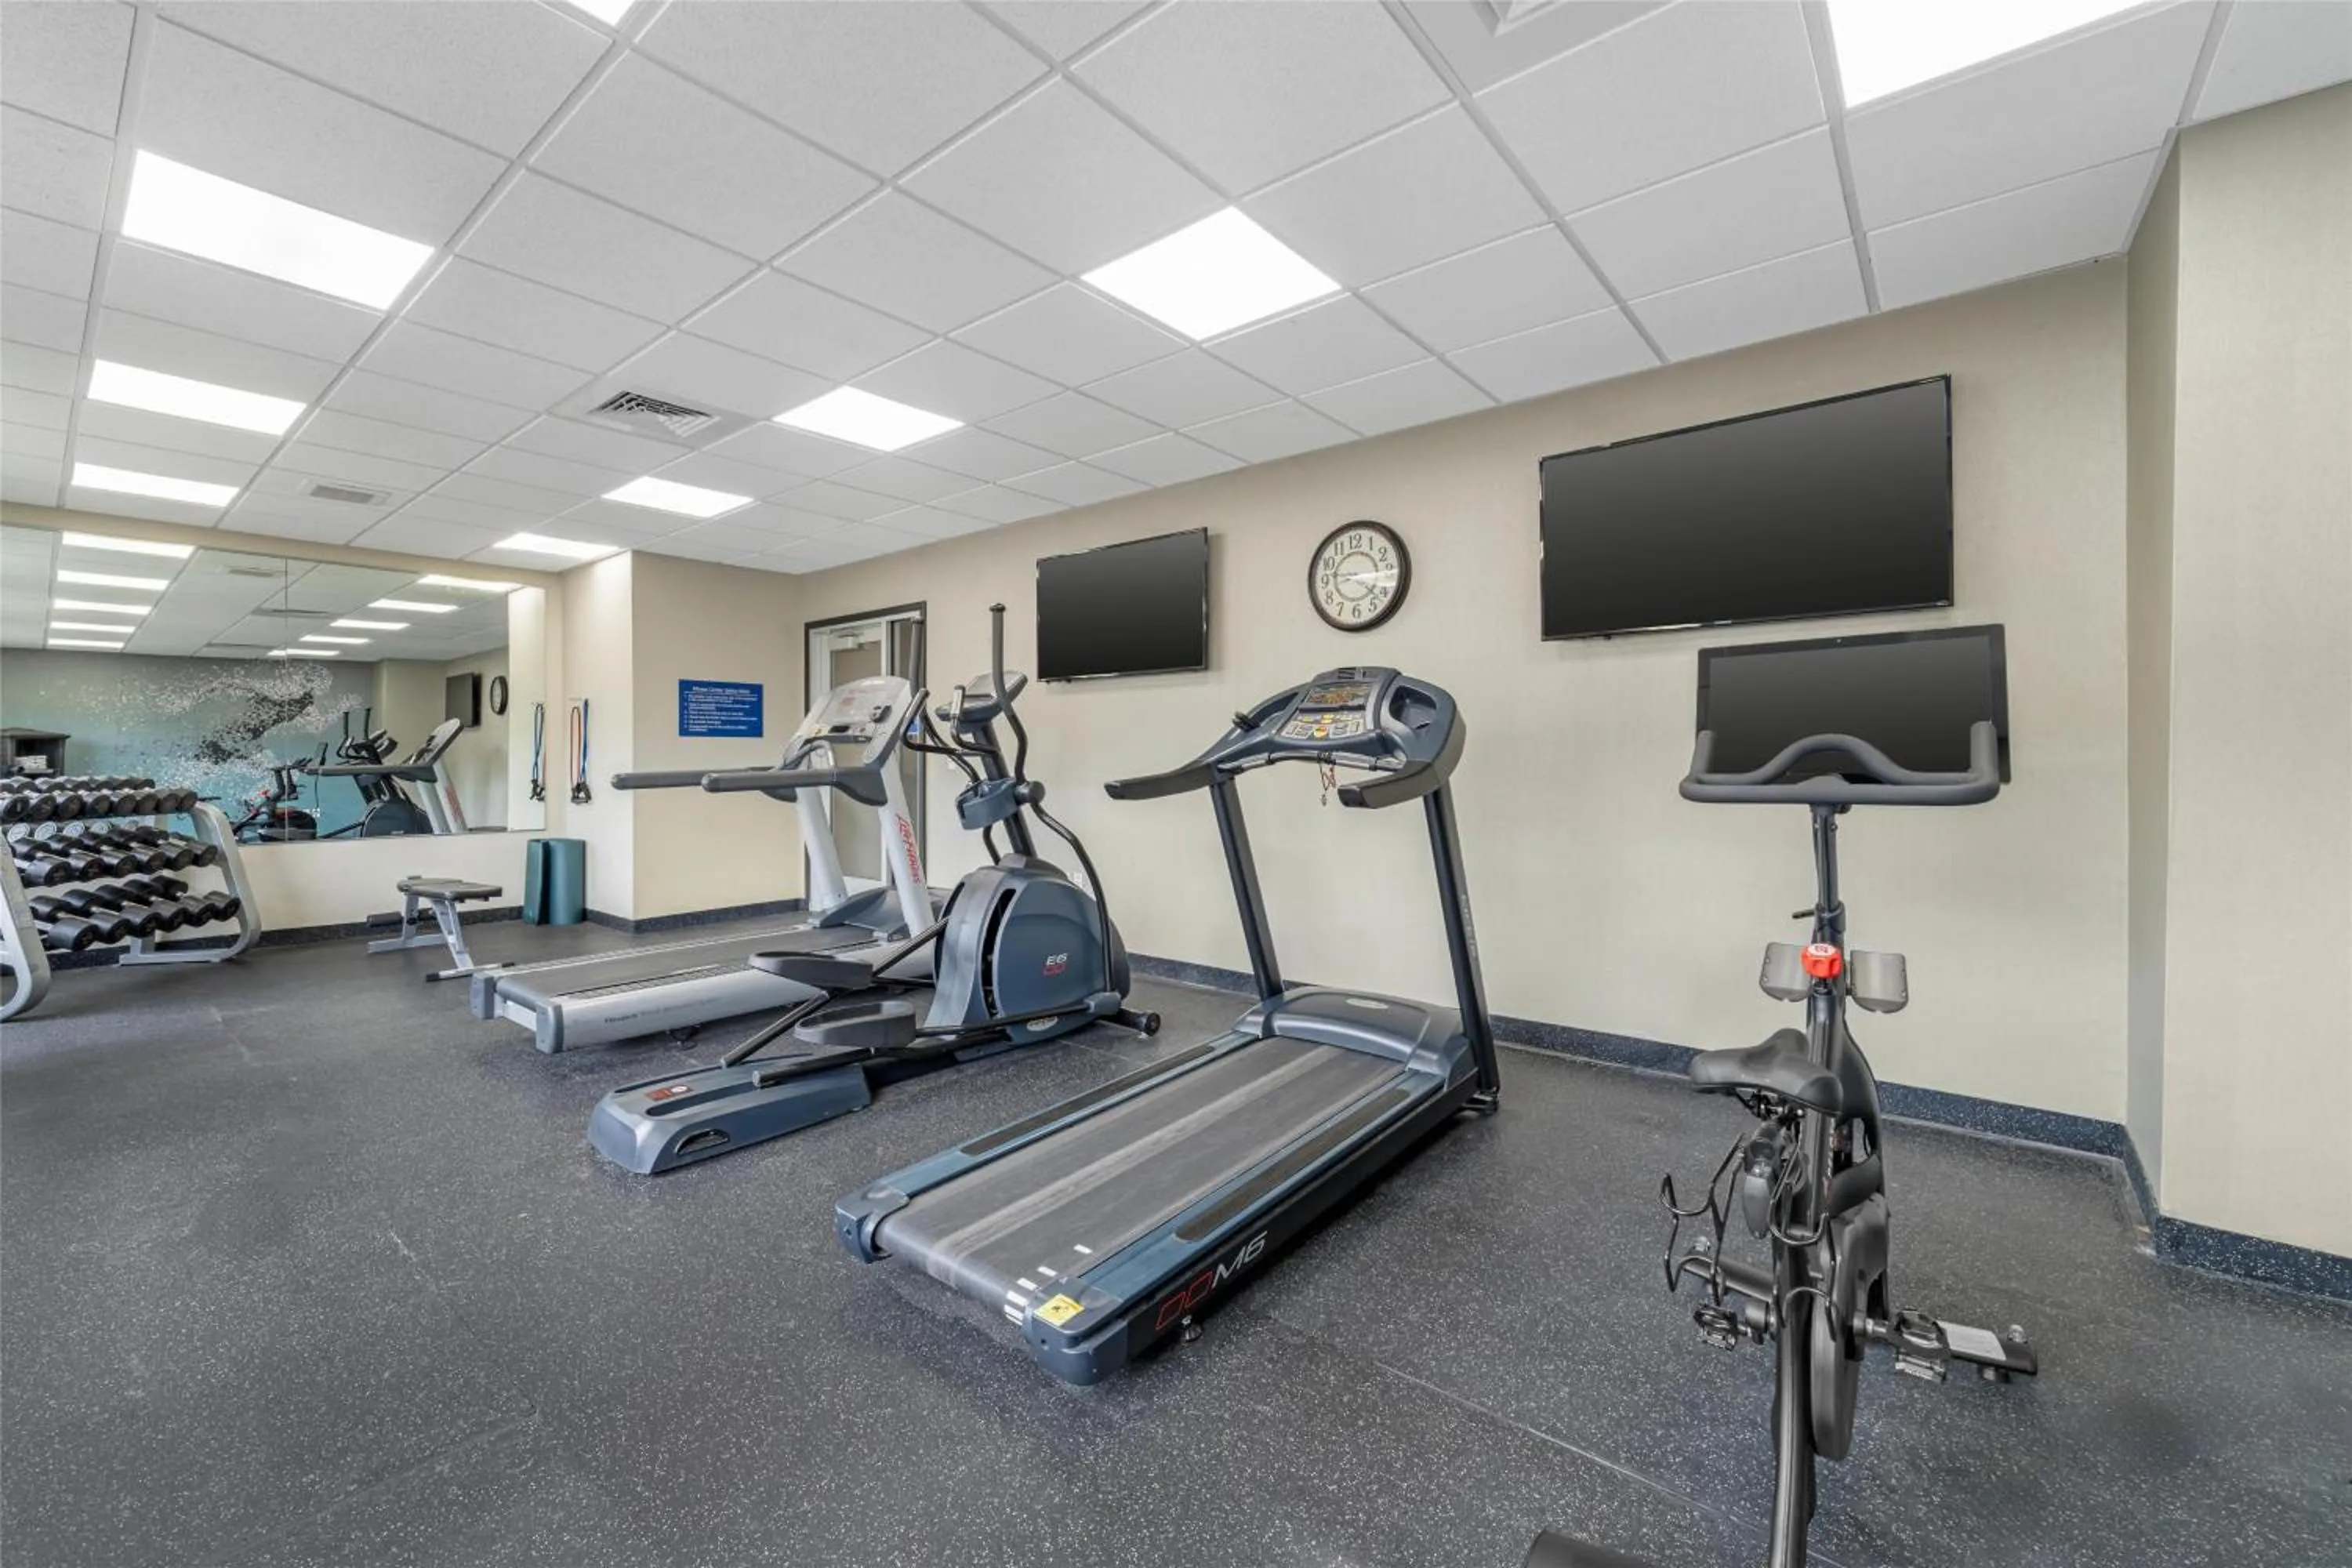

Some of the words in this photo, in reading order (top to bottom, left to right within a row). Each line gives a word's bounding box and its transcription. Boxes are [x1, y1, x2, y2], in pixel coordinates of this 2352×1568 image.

[1348, 533, 1362, 550] 12
[1369, 535, 1374, 551] 1
[1334, 542, 1345, 557] 11
[1378, 546, 1387, 562] 2
[1323, 557, 1335, 571] 10
[1321, 574, 1329, 590] 9
[1325, 590, 1334, 605] 8
[1368, 597, 1377, 612] 5
[1336, 601, 1344, 617] 7
[1352, 604, 1361, 619] 6
